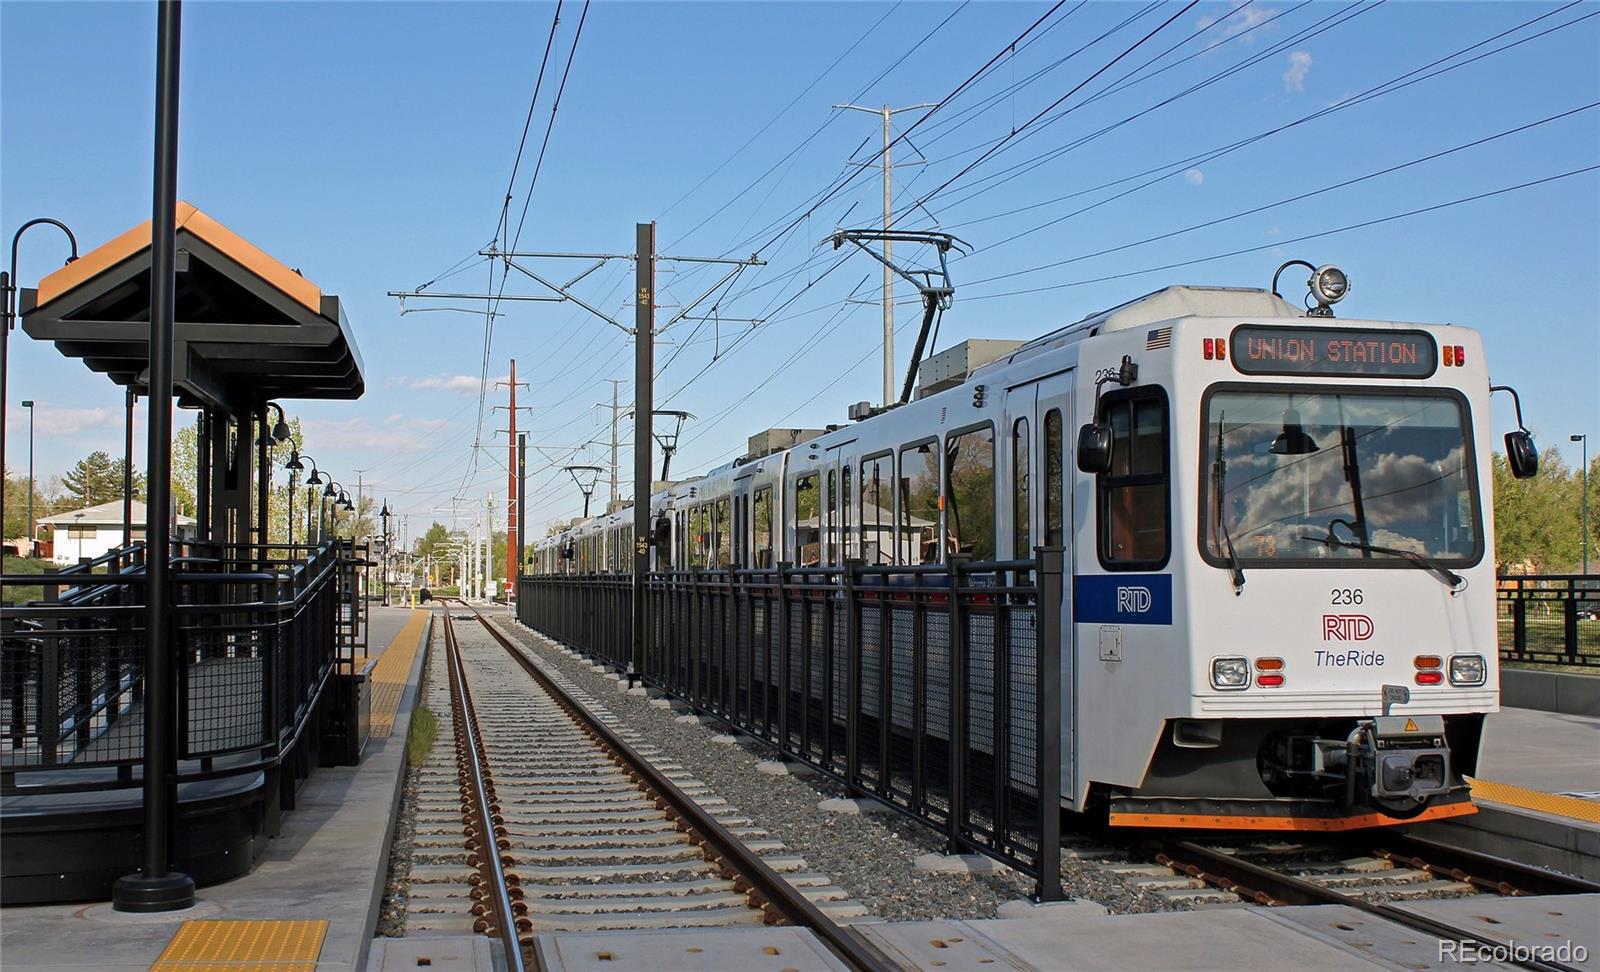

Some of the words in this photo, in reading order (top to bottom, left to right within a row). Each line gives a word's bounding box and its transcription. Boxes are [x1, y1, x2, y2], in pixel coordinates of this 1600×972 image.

[1247, 337, 1314, 361] UNION
[1327, 340, 1417, 364] STATION
[1117, 586, 1152, 613] RTD
[1331, 589, 1363, 605] 236
[1322, 614, 1375, 641] RTD
[1314, 650, 1385, 667] TheRide
